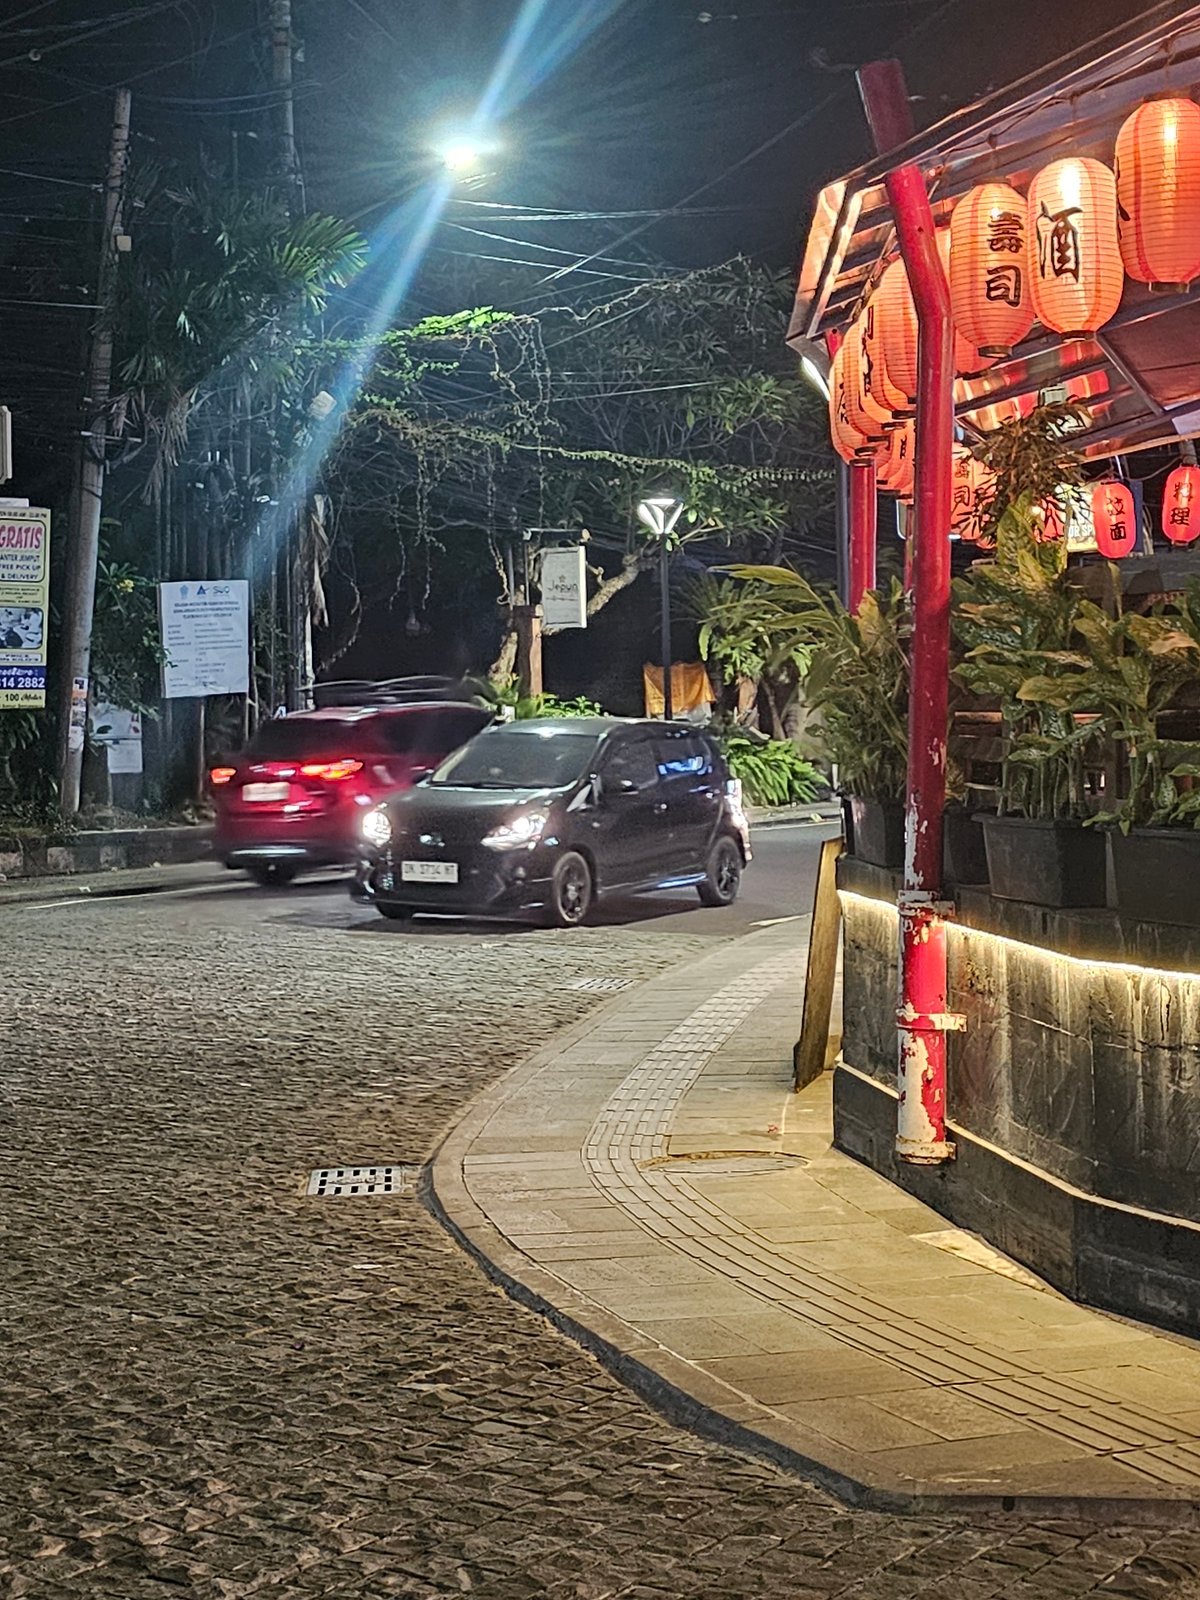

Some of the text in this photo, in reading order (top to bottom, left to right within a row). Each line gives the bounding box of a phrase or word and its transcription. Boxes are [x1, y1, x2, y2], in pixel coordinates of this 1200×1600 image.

[0, 525, 43, 549] GRATIS
[17, 677, 45, 688] 2882
[5, 693, 19, 702] 100
